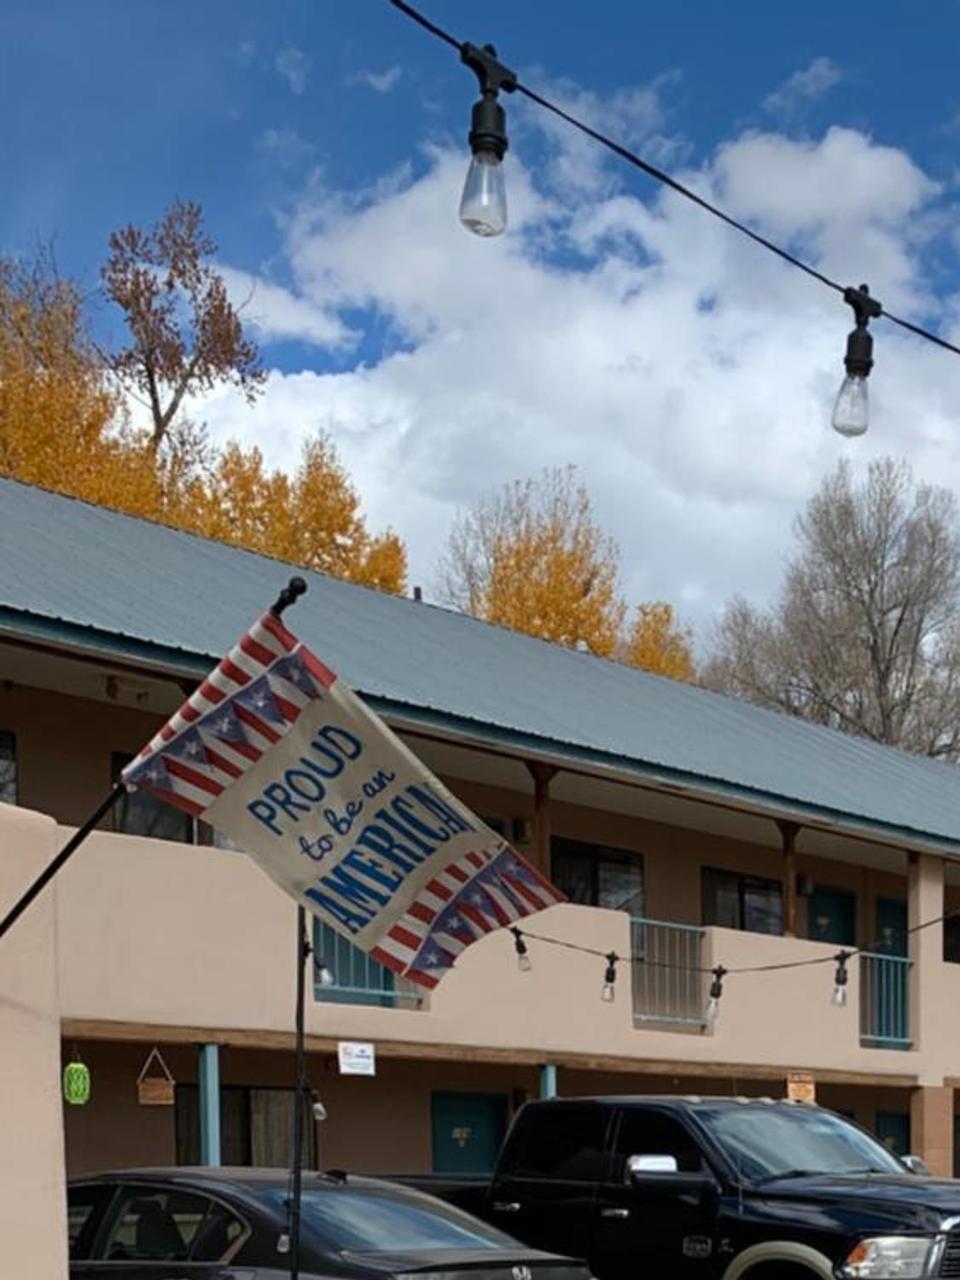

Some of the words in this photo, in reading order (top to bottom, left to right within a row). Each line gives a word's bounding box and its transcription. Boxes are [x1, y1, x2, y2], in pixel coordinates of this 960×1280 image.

[247, 724, 363, 836] PROUD
[299, 836, 334, 861] to
[324, 799, 363, 835] be
[363, 769, 395, 798] an
